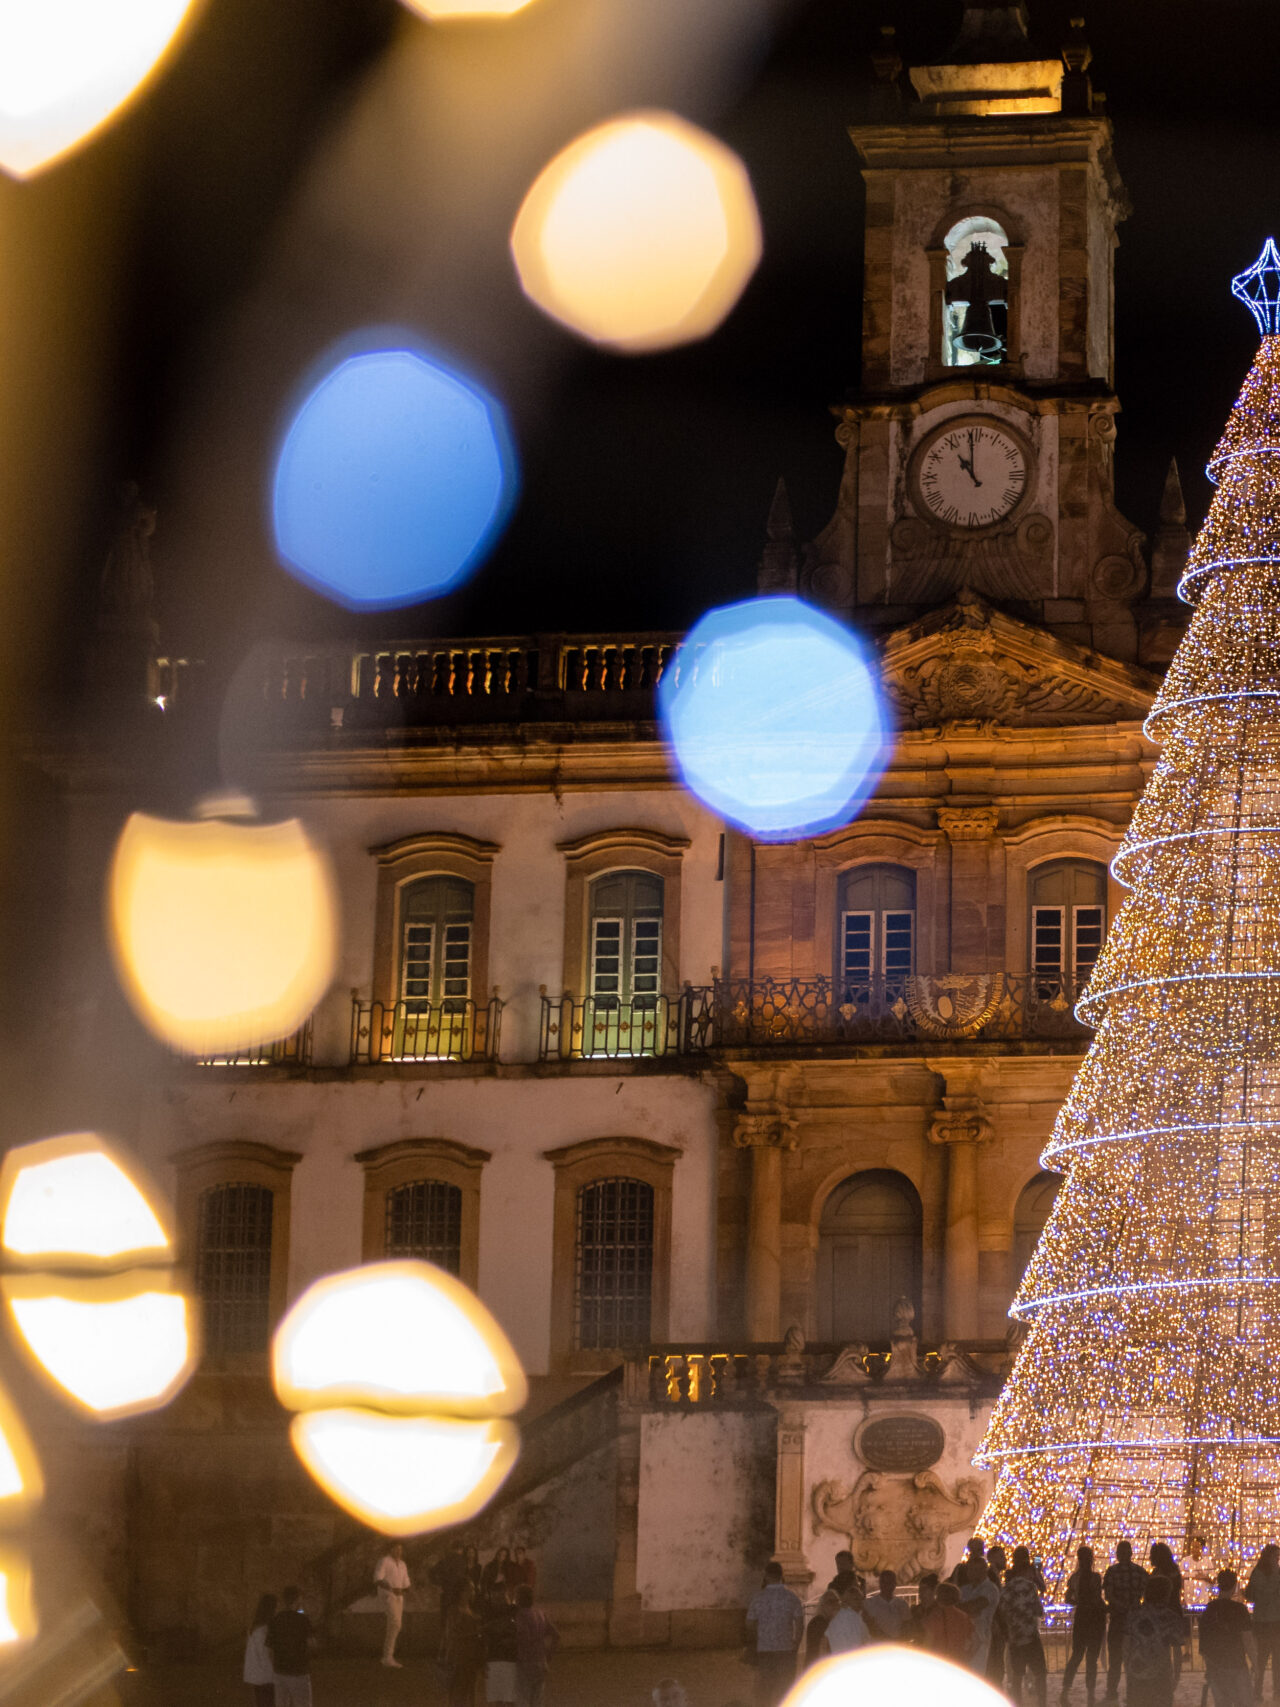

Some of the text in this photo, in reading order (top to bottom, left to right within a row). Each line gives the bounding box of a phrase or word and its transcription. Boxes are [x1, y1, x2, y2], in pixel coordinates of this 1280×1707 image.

[944, 432, 960, 450] XI
[991, 433, 1000, 446] I
[928, 450, 943, 464] X
[1004, 448, 1019, 460] II
[922, 473, 938, 485] IX
[1009, 470, 1024, 480] III
[926, 490, 944, 512] VIII
[1002, 488, 1020, 505] IIII
[968, 511, 980, 528] VI
[990, 507, 1001, 521] V
